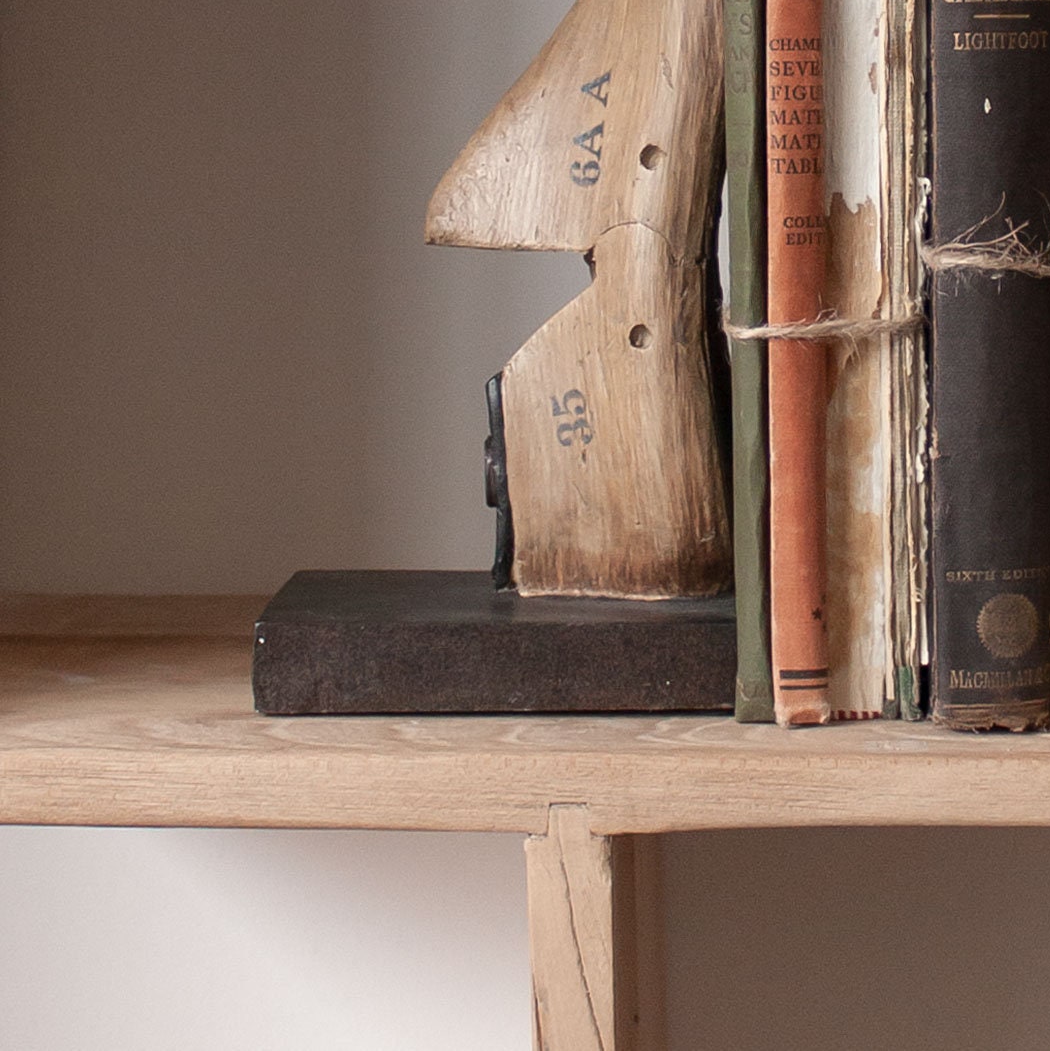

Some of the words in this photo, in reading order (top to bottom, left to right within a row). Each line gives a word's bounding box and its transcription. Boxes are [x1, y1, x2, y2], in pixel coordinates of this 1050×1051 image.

[953, 30, 1049, 51] LIGHTFOOT
[550, 387, 595, 449] 35
[946, 569, 996, 583] SIXTH
